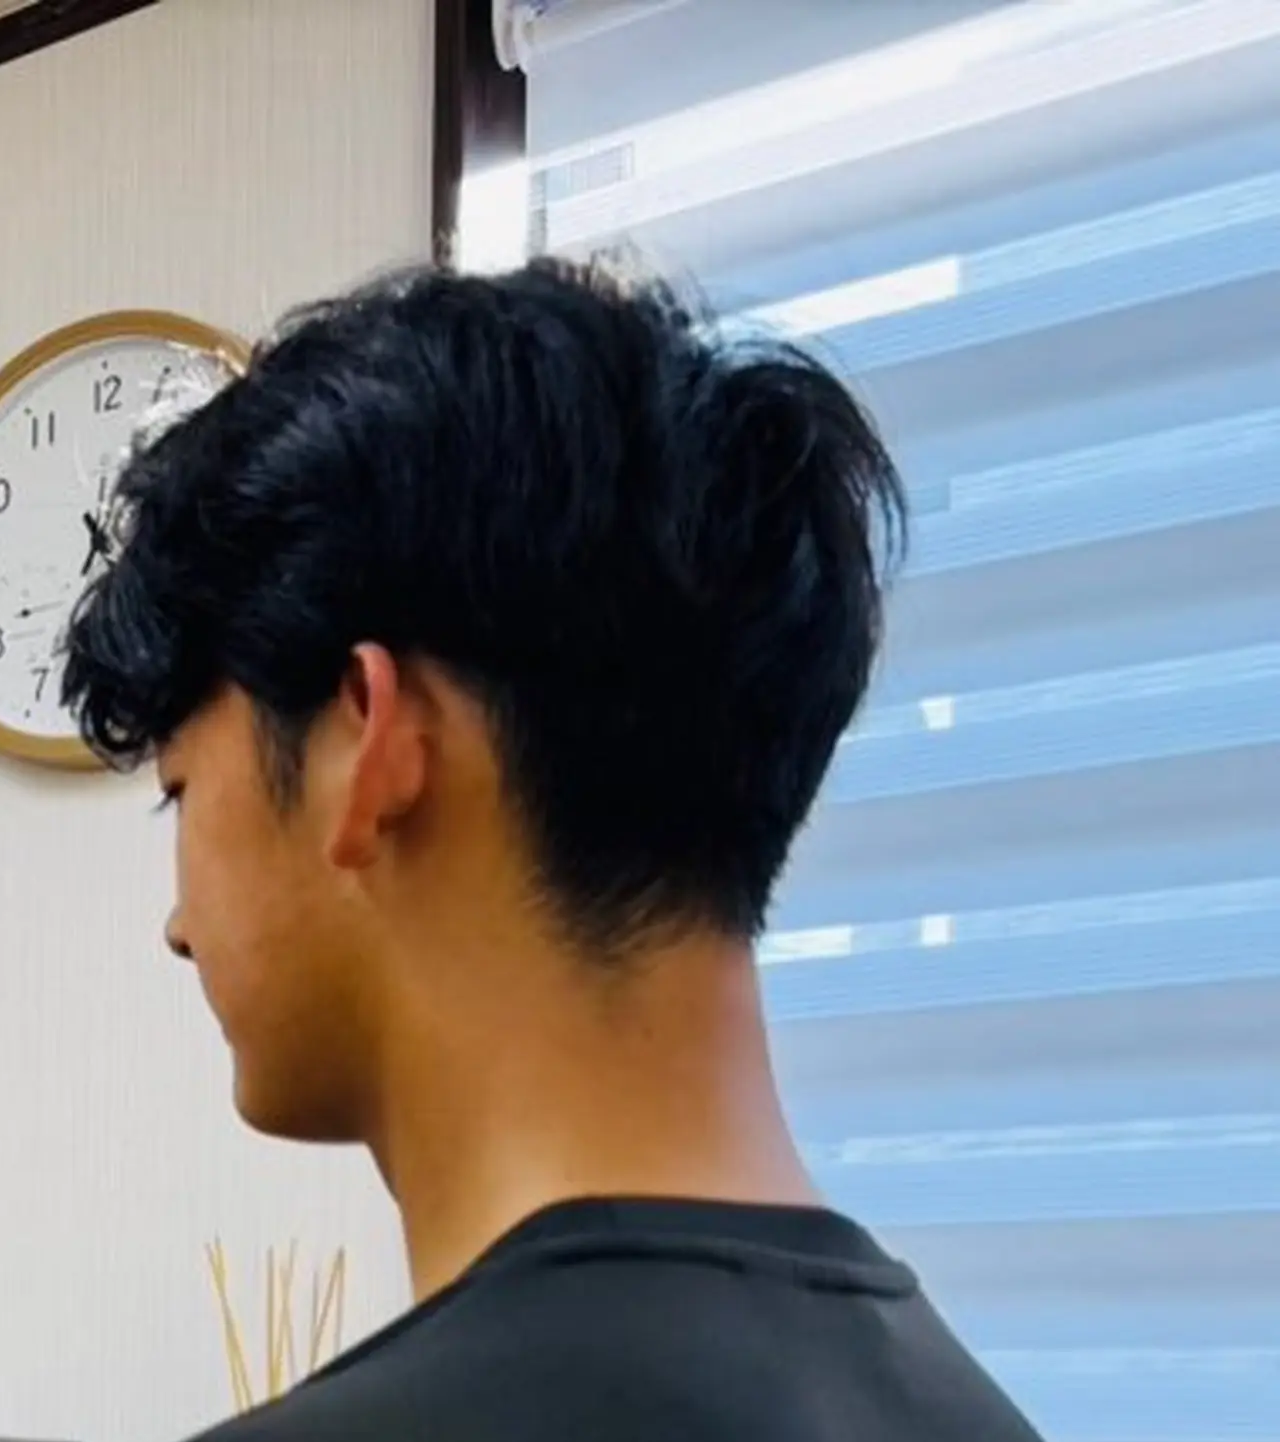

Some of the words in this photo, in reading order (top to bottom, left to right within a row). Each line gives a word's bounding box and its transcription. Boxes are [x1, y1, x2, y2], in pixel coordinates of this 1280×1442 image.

[93, 375, 122, 413] 12
[31, 411, 56, 449] 11
[31, 668, 49, 703] 7
